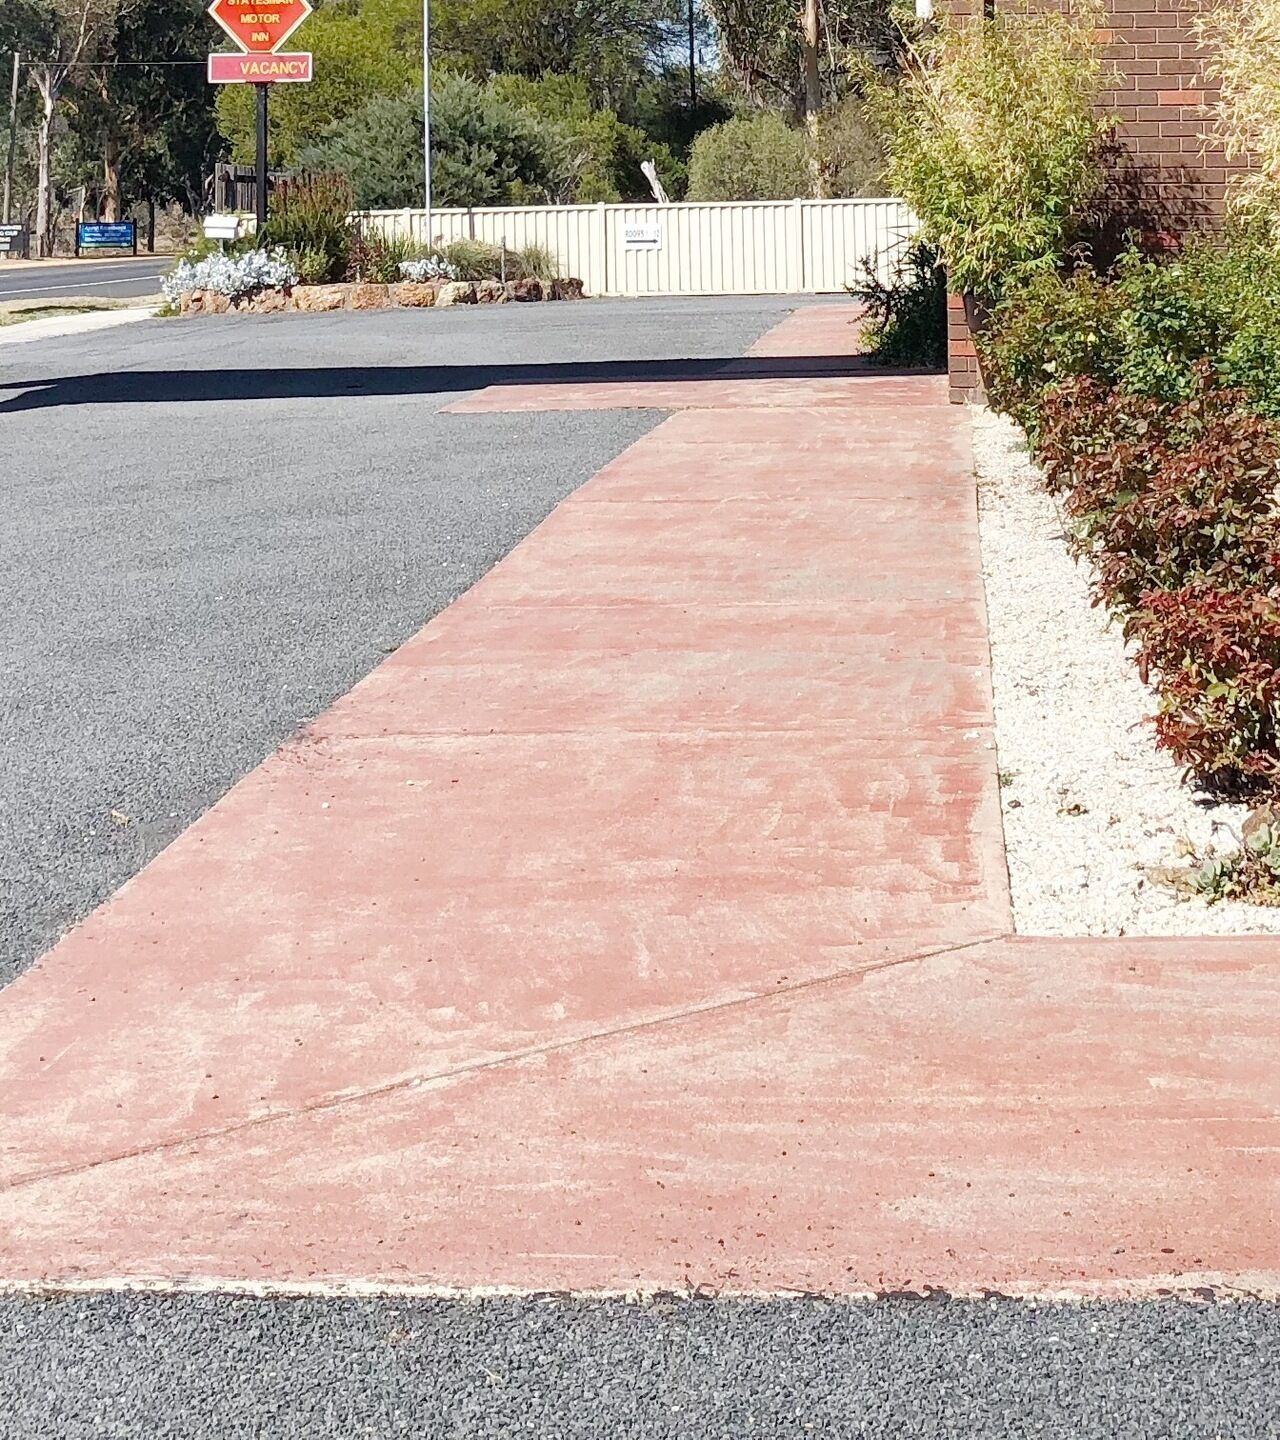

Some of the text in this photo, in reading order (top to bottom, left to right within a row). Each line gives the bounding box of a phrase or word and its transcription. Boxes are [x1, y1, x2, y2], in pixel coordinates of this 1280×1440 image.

[240, 14, 280, 24] MOTOR
[251, 32, 269, 42] INN
[240, 61, 307, 75] VACANCY
